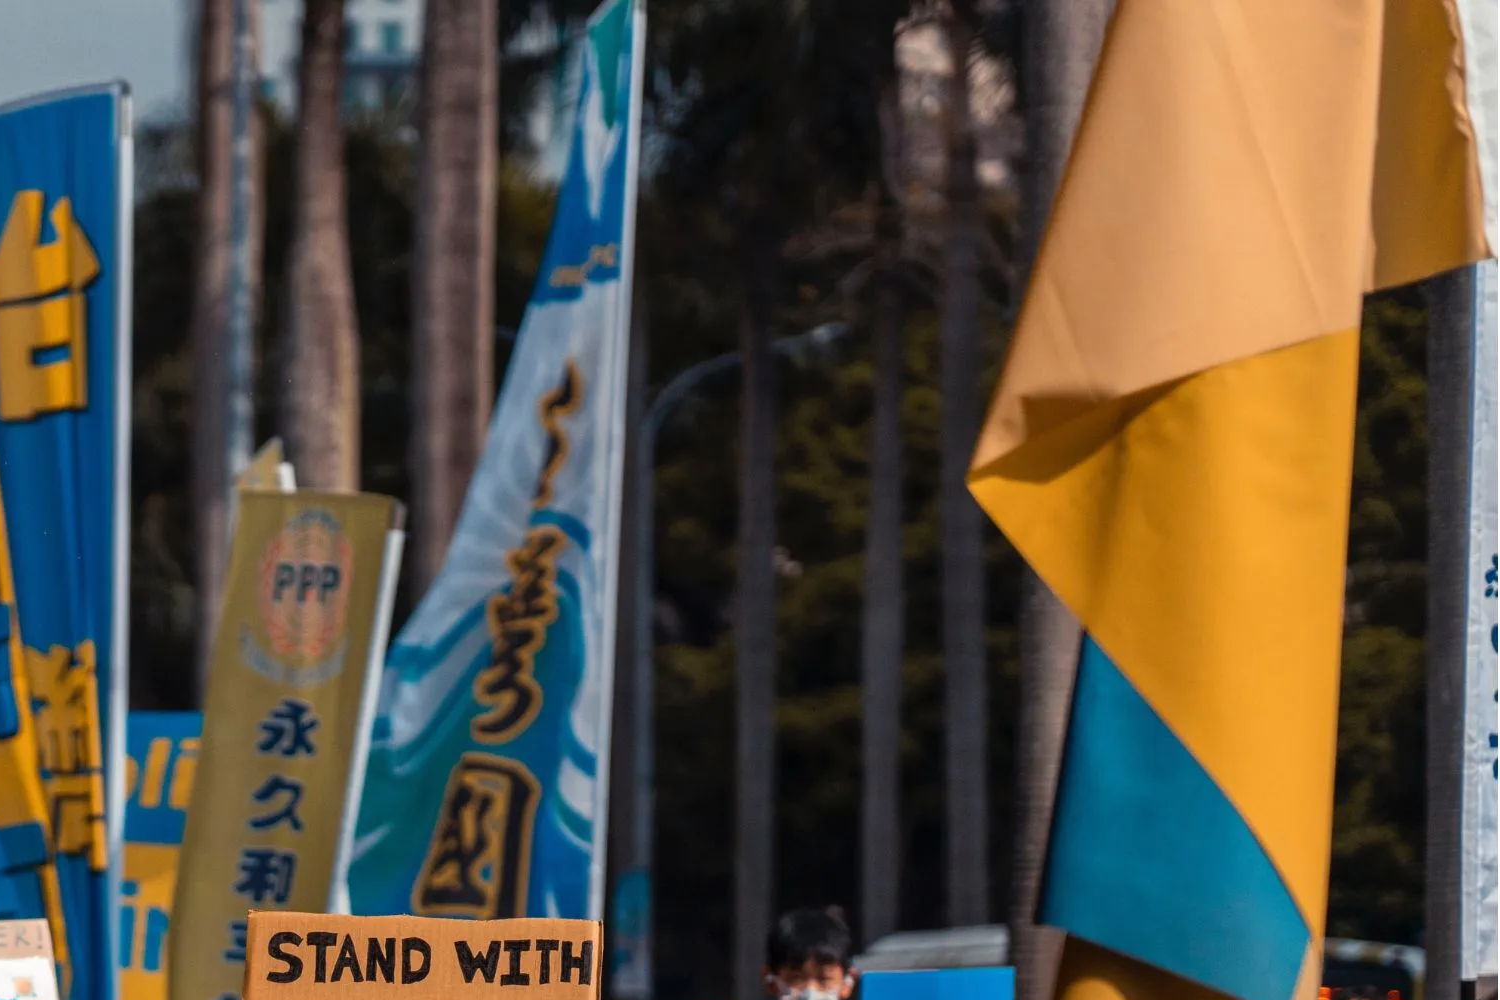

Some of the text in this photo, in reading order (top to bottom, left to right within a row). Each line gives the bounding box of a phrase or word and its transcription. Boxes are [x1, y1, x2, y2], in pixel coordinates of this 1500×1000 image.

[271, 561, 340, 605] PPP
[267, 931, 593, 986] STAND WITH
